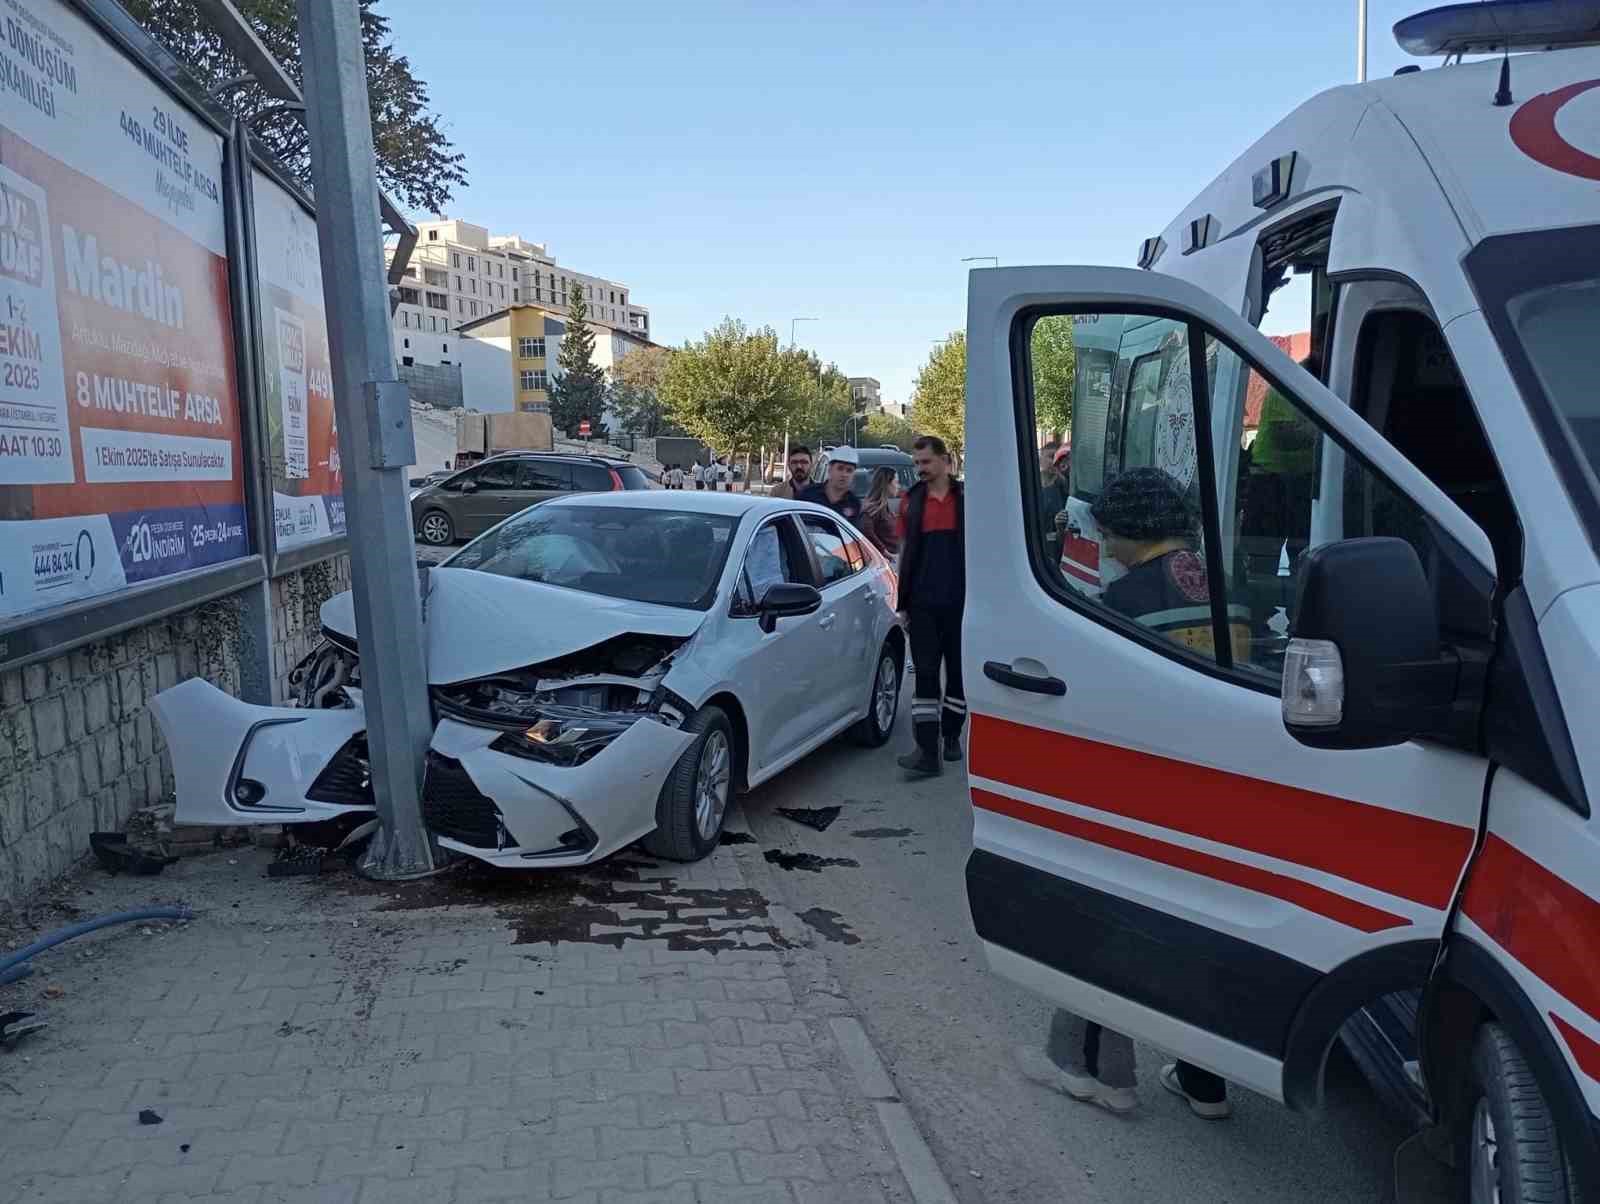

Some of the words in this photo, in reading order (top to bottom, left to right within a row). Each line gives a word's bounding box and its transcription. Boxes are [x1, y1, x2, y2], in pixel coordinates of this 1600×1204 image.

[152, 106, 166, 135] 29
[120, 111, 142, 146] 449
[194, 168, 219, 205] ARSA
[62, 224, 184, 328] Mardin
[4, 362, 40, 390] 2025
[77, 371, 90, 408] 8
[94, 374, 180, 419] MUHTELİF
[184, 392, 223, 425] ARSA
[31, 436, 62, 457] 10.30
[95, 447, 100, 467] 1
[102, 447, 125, 467] Ekim
[159, 450, 182, 471] Satışa
[152, 535, 186, 561] İNDİRİM
